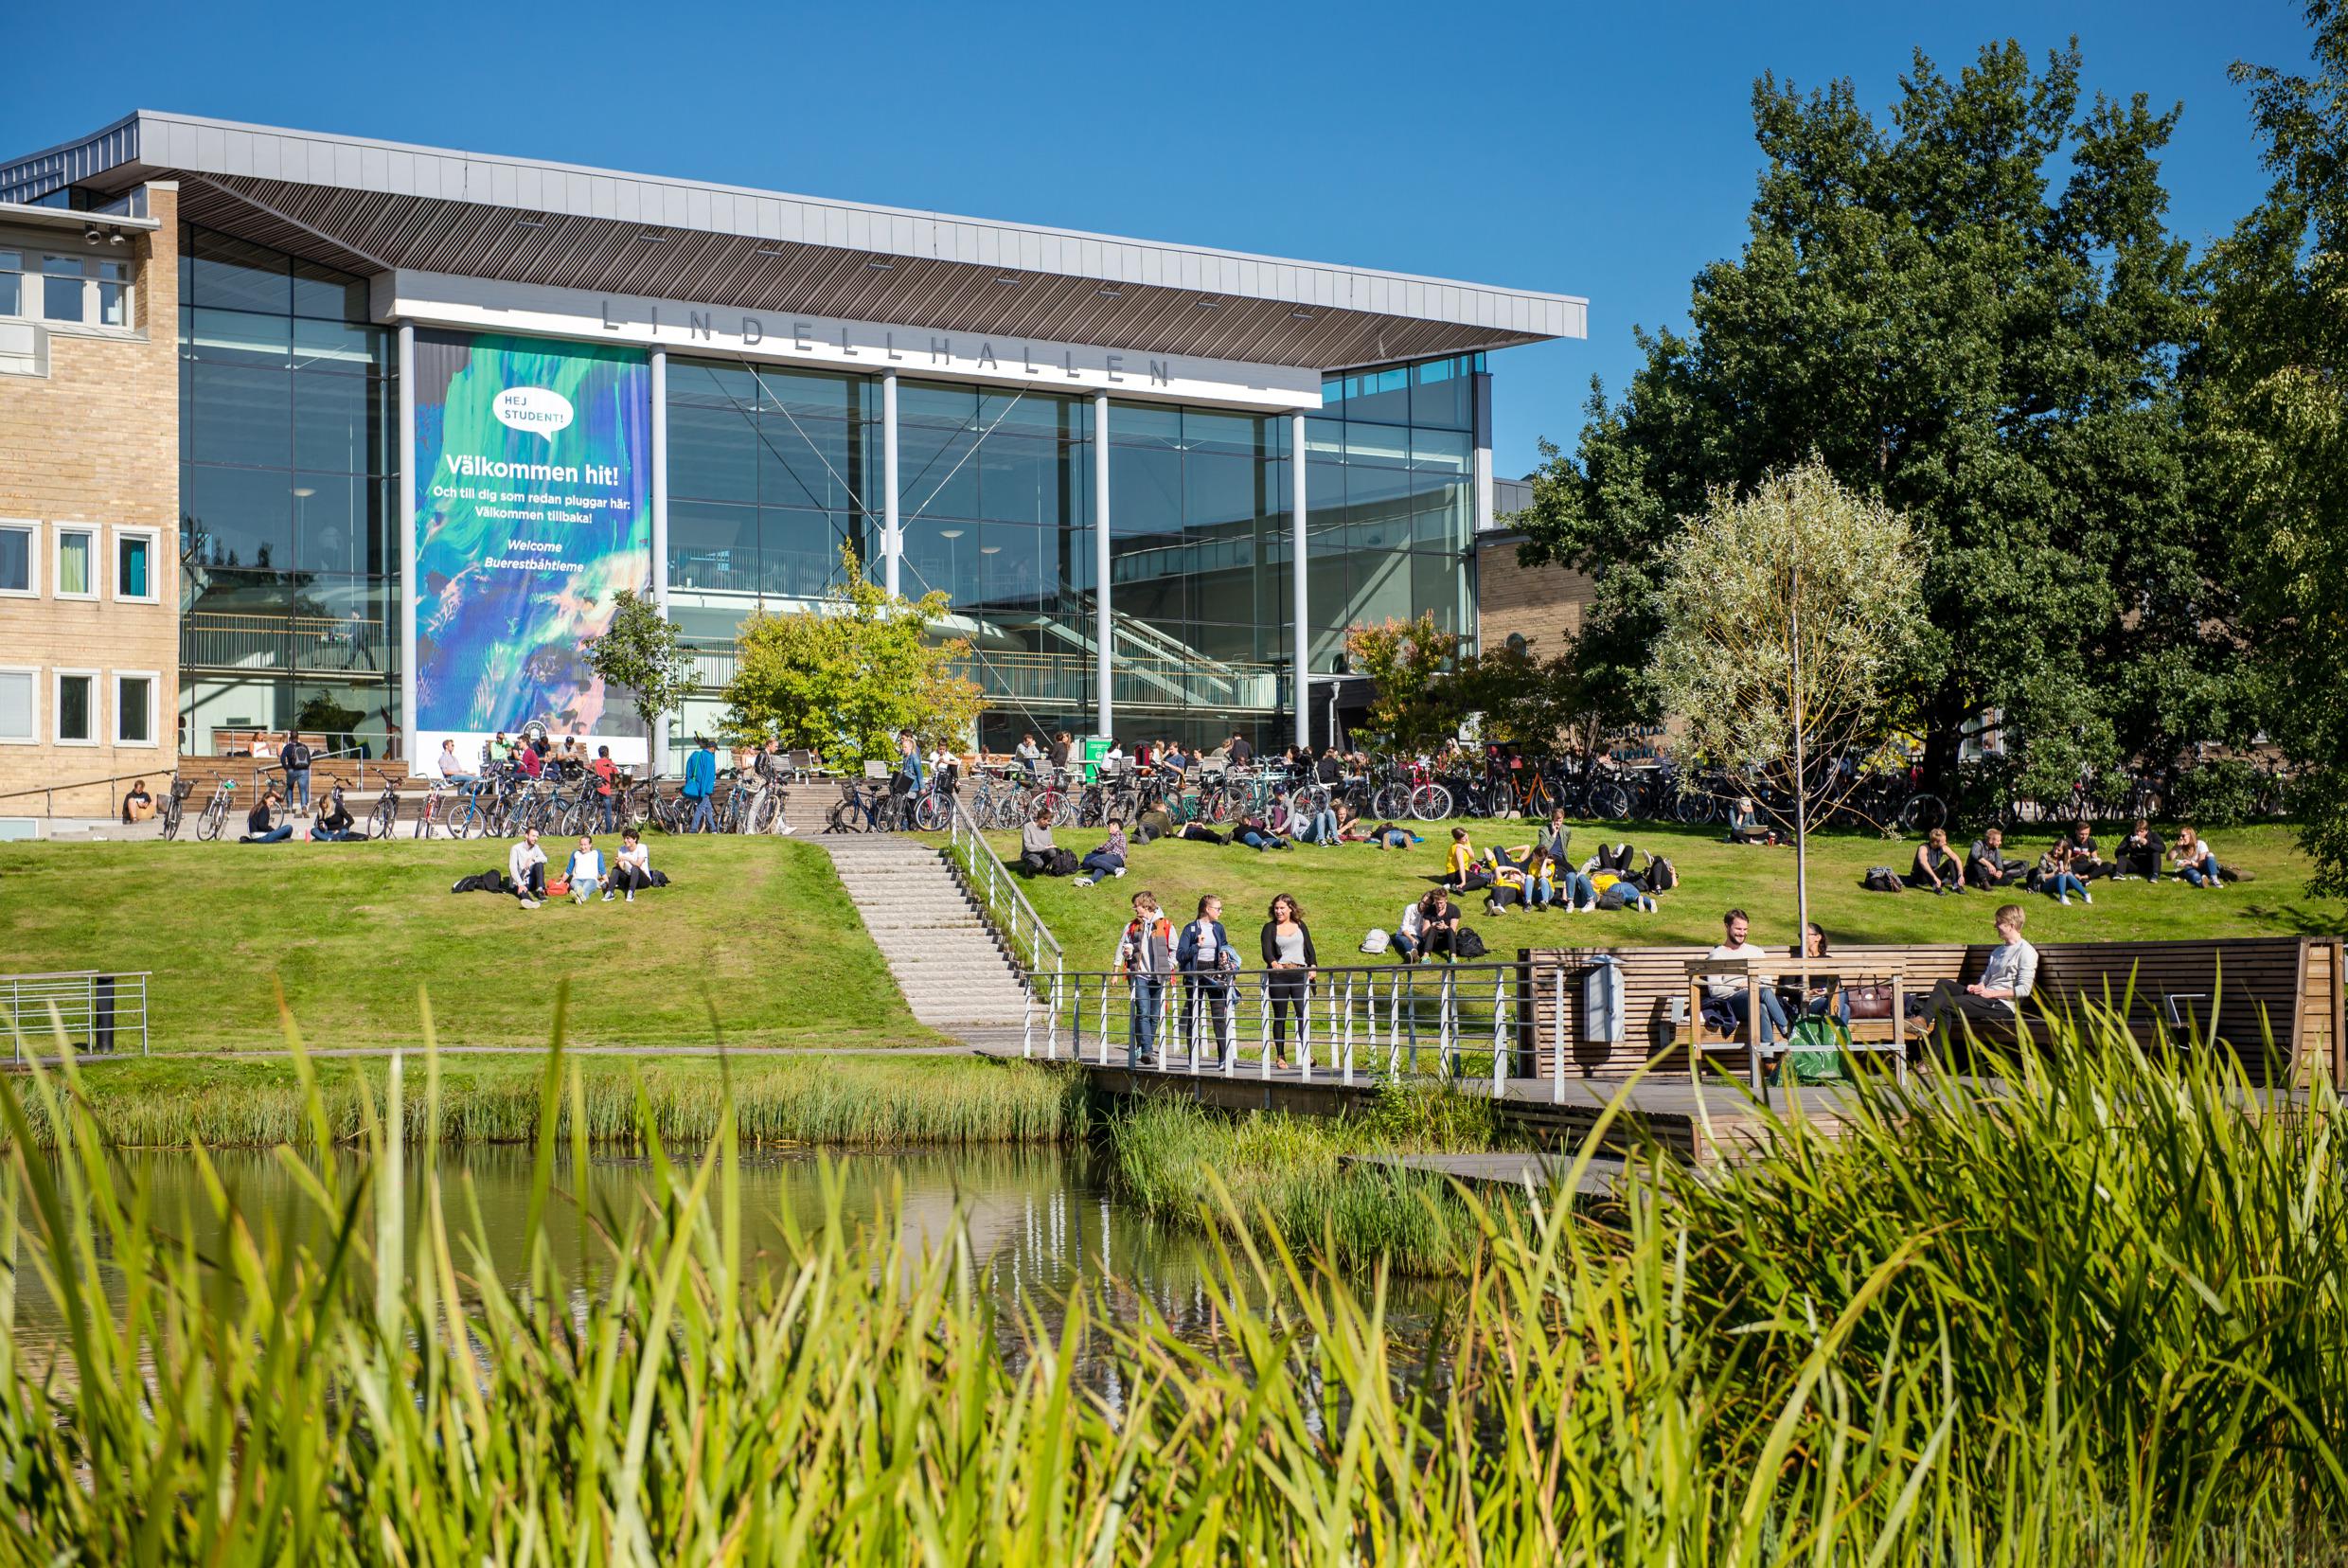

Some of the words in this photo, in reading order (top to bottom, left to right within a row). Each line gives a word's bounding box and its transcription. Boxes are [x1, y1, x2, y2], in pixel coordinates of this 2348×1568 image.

[602, 300, 1169, 387] LINDELLHALLEN
[505, 396, 527, 406] HEJ
[505, 409, 564, 423] STUDENT!
[446, 454, 578, 483] Välkommen
[585, 464, 618, 486] hit!
[433, 485, 457, 498] Och
[459, 487, 475, 499] till
[478, 489, 497, 502] dig
[500, 491, 525, 503] som
[527, 492, 562, 505] redan
[564, 494, 608, 509] pluggar
[610, 497, 631, 510] här:
[474, 506, 543, 521] Välkommen
[547, 509, 593, 525] tillbaka!
[507, 539, 562, 553] Welcome
[484, 557, 584, 573] Buerestbåhtieme
